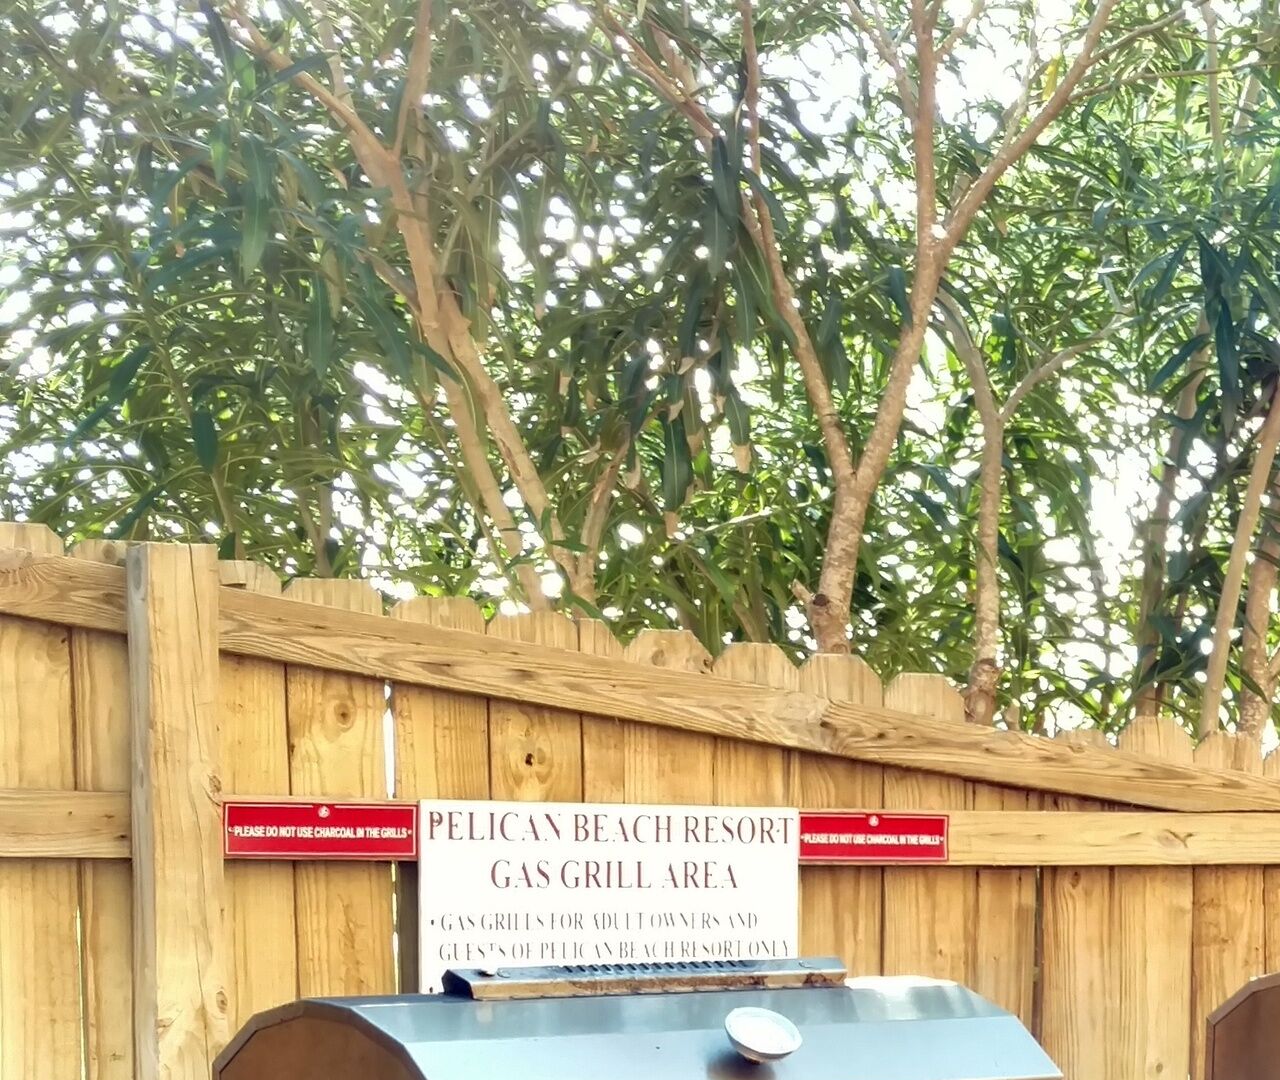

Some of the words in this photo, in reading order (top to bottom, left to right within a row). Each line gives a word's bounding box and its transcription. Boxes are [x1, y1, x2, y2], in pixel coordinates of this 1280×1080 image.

[233, 825, 266, 837] PLEASE
[266, 826, 278, 837] DO
[279, 826, 296, 838] NOT
[296, 826, 314, 838] USE
[314, 826, 355, 838] CHARCOAL
[356, 827, 365, 838] IN
[365, 827, 380, 839] THE
[381, 827, 408, 839] GRILLS
[428, 811, 562, 842] PELICAN
[573, 813, 672, 843] BEACH
[684, 815, 794, 844] RESORT
[490, 859, 551, 889] GAS
[560, 859, 652, 889] GRILL
[662, 861, 738, 889] AREA
[440, 912, 476, 931] GAS
[550, 912, 584, 931] FOR
[650, 912, 720, 930] OWNERS
[728, 912, 759, 929] AND
[540, 941, 613, 960] PELICAN
[619, 941, 675, 959] BEACH
[680, 940, 741, 958] RESORT
[748, 940, 790, 958] ONLY
